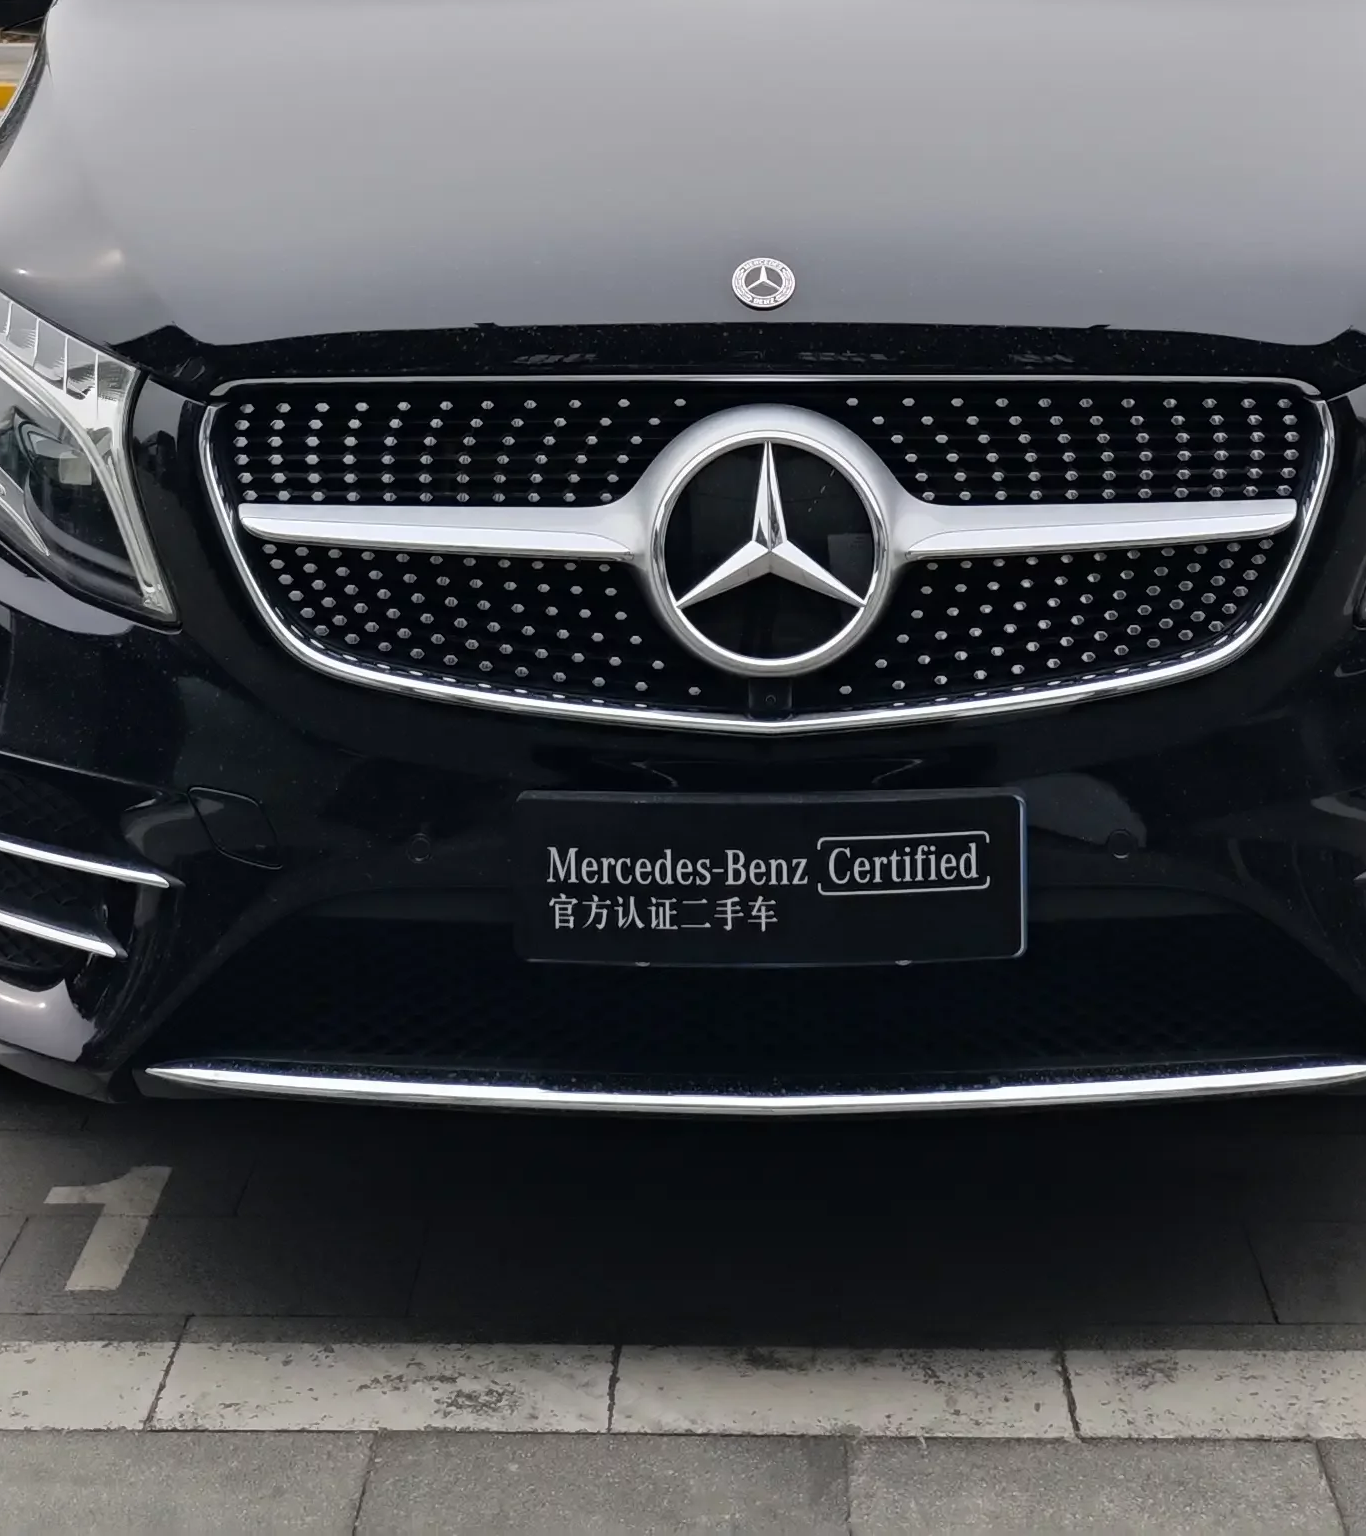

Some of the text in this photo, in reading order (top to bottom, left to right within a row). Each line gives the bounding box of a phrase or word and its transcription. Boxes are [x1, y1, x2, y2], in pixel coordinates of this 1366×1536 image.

[546, 843, 981, 887] Mercedes-Benz Certified
[548, 893, 779, 933] 官方认证二手车
